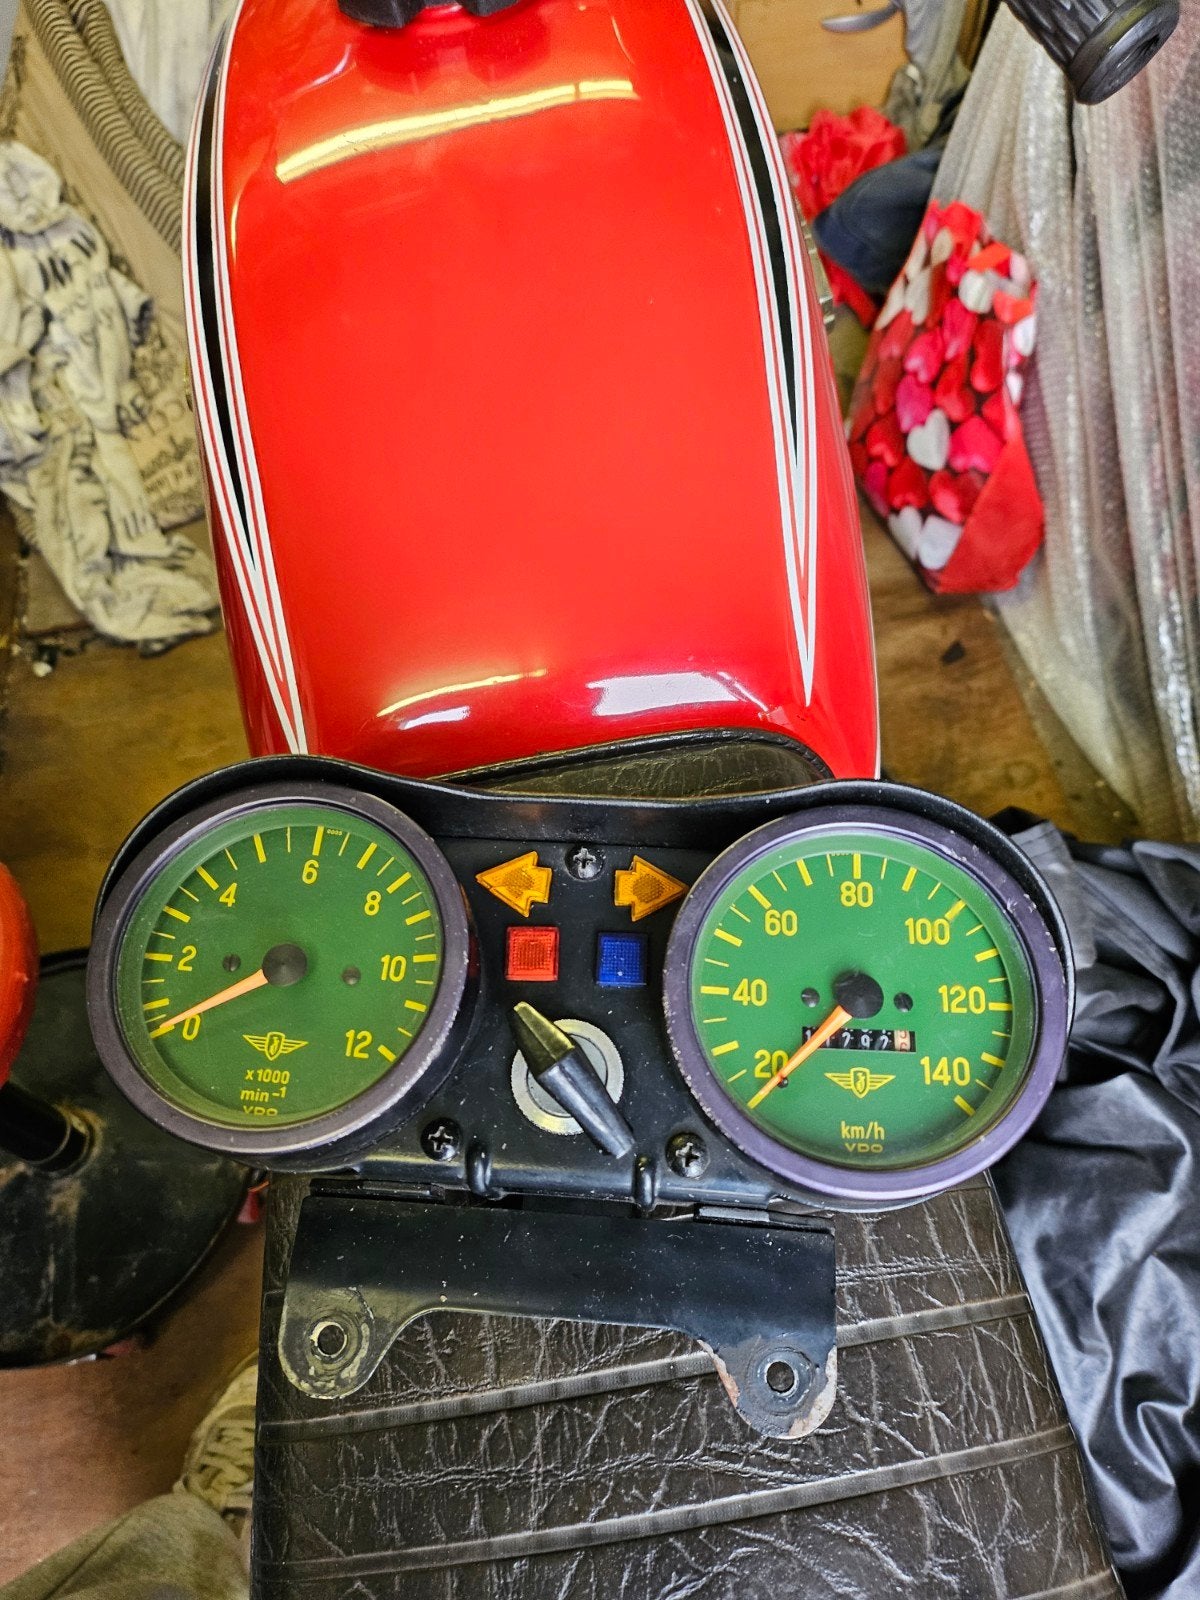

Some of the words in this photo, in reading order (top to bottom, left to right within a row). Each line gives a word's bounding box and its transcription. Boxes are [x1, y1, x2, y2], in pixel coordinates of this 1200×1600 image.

[302, 859, 320, 885] 6
[219, 882, 238, 908] 4
[364, 891, 382, 916] 8
[840, 882, 873, 907] 80
[765, 909, 798, 936] 60
[905, 917, 950, 945] 100
[177, 945, 197, 972] 2
[381, 955, 407, 982] 10
[733, 978, 768, 1006] 40
[938, 985, 986, 1014] 120
[182, 1013, 201, 1041] 0
[345, 1029, 373, 1059] 12
[257, 1068, 290, 1085] 1000
[754, 1049, 789, 1079] 20
[920, 1057, 970, 1086] 140
[240, 1088, 270, 1103] min
[841, 1120, 885, 1141] km/h
[844, 1142, 883, 1154] VDO
